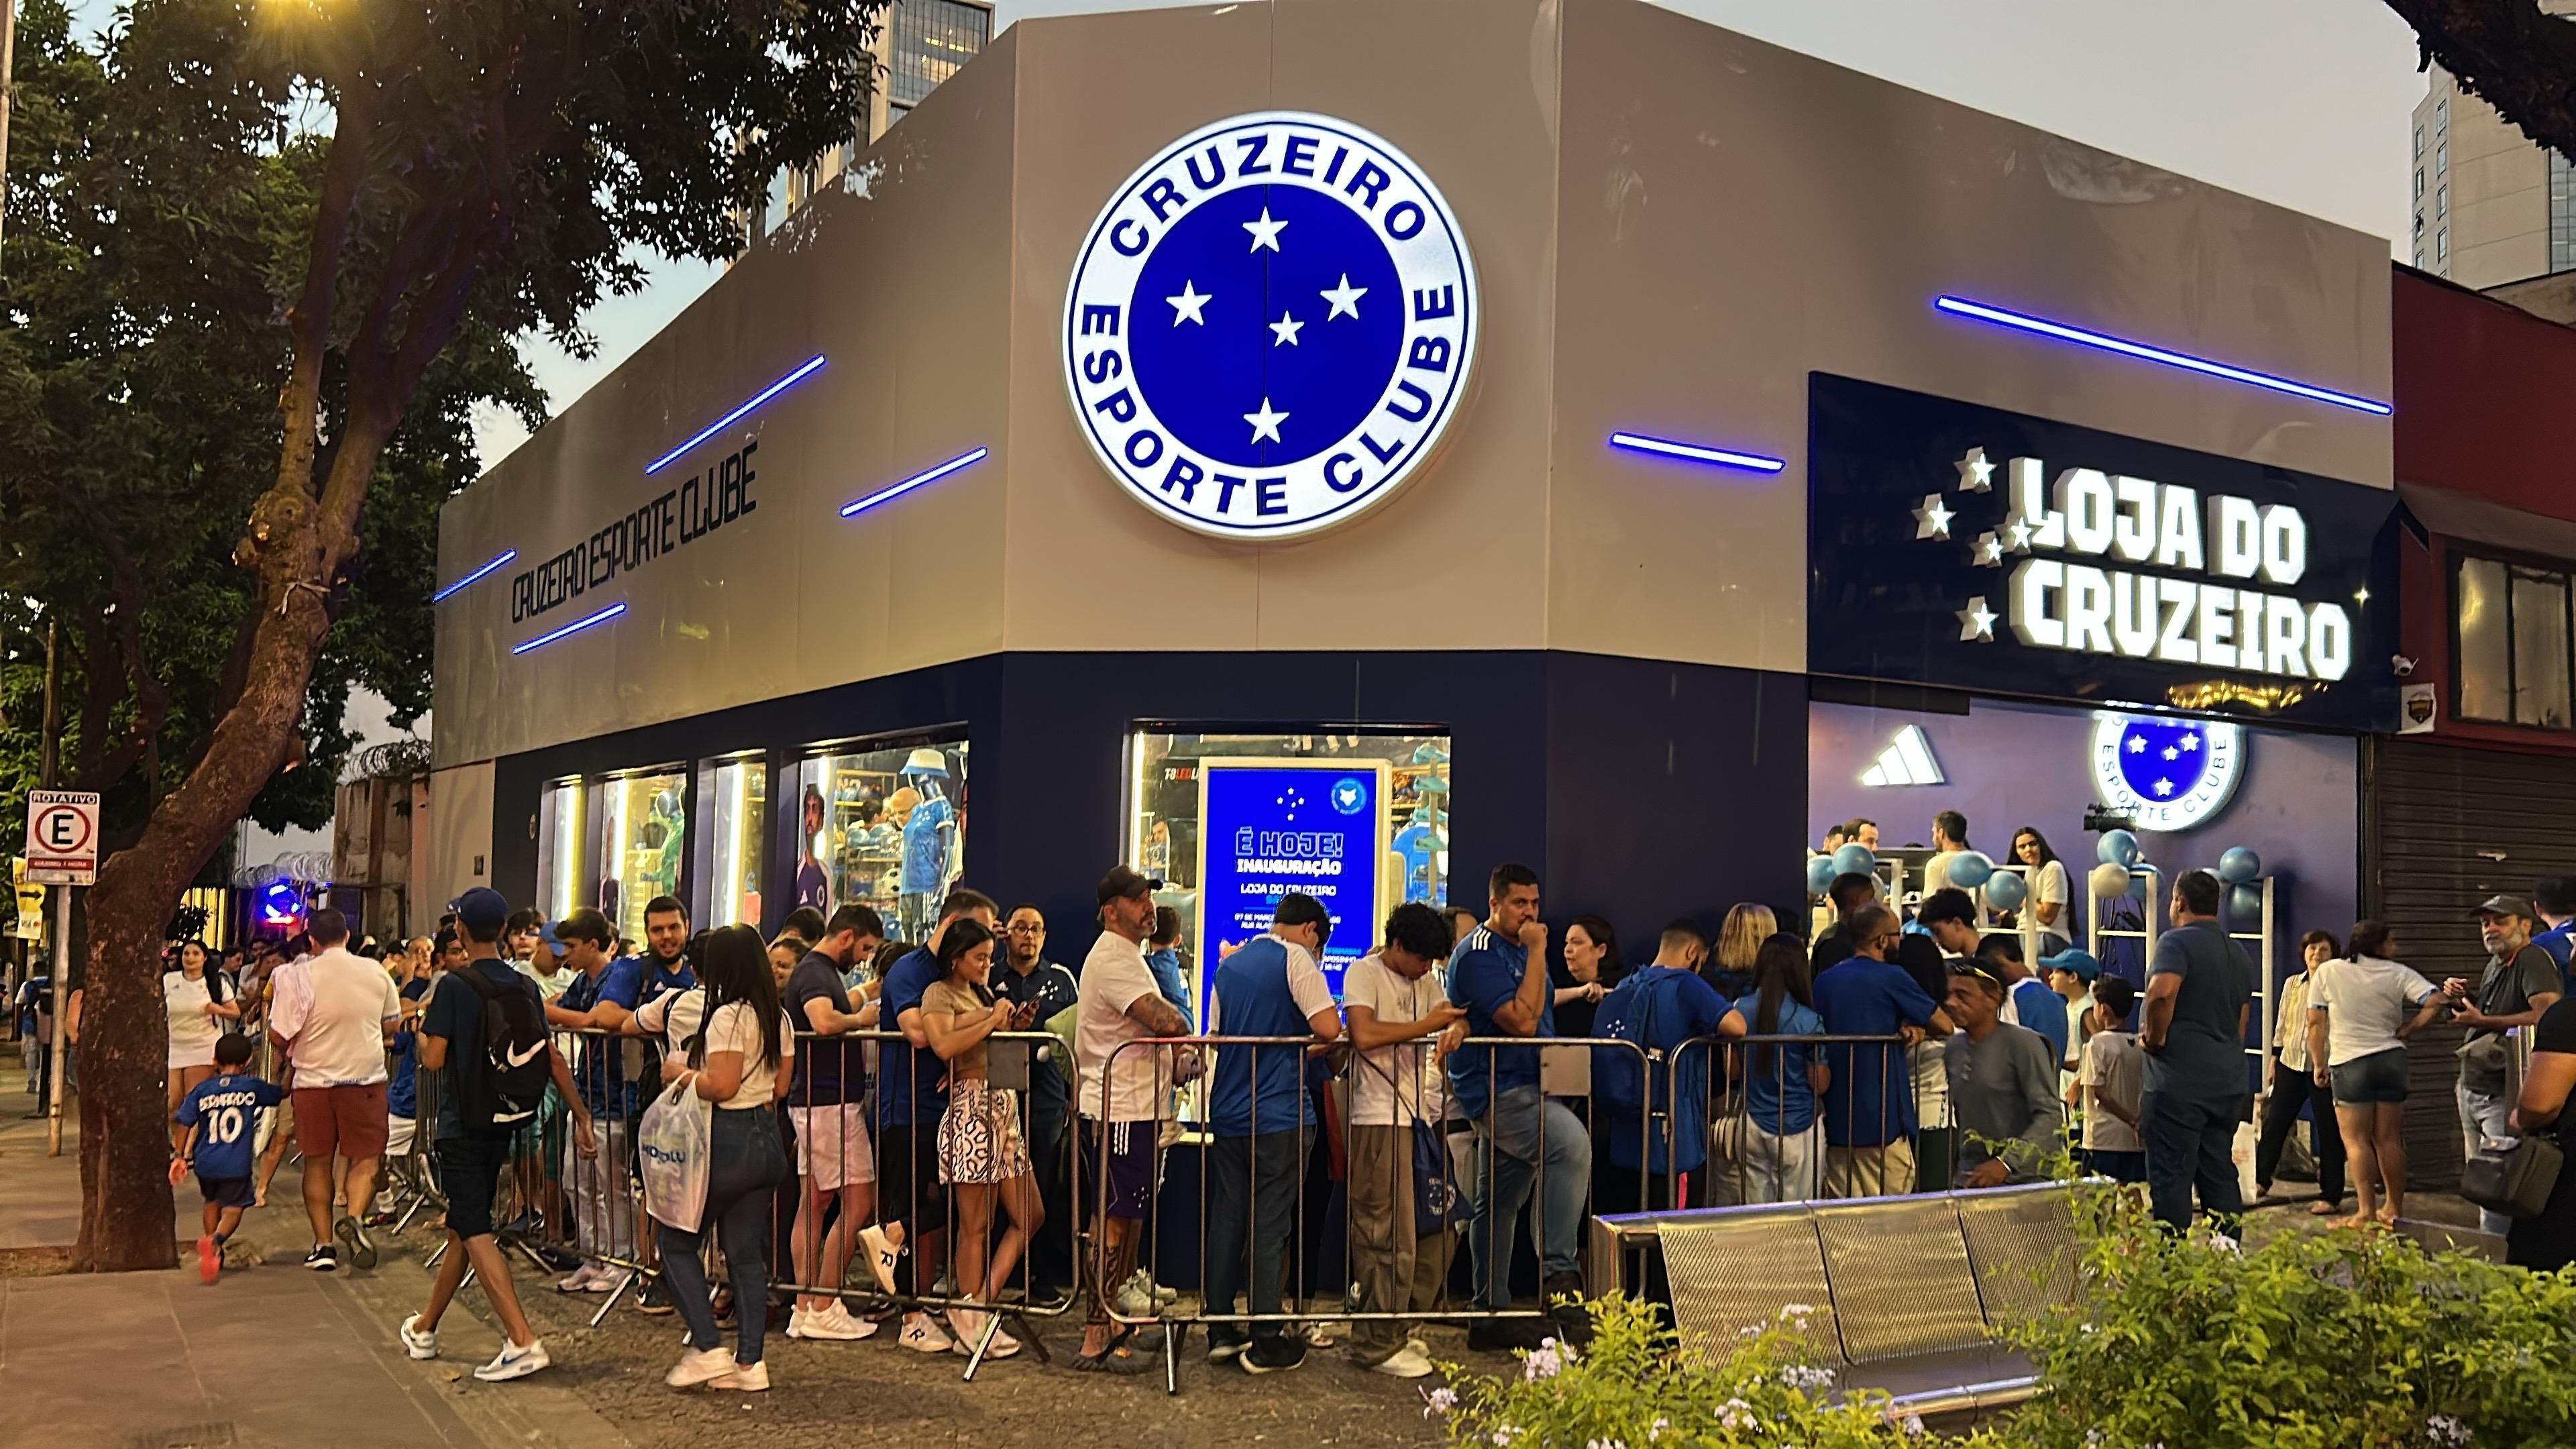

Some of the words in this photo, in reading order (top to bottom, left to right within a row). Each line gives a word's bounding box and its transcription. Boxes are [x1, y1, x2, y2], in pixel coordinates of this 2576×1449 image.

[1110, 134, 1426, 257] CRUZEIRO
[1081, 303, 1289, 517] ESPORTE
[1323, 283, 1455, 493] CLUBE
[512, 541, 587, 624] CRUZEIRO
[589, 488, 677, 588] ESPORTE
[680, 439, 759, 545] CLUBE
[2009, 456, 2204, 570] LOJA
[2208, 494, 2307, 585] DO
[2009, 557, 2351, 682] CRUZEIRO
[33, 792, 96, 804] ROTATIVO
[2183, 739, 2227, 813] CLUBE
[52, 814, 74, 845] E
[1235, 826, 1253, 856] É
[1260, 831, 1344, 858] HOJE!
[1236, 858, 1342, 877] INAUGURAÇÃO
[1241, 883, 1267, 894] LOJA
[1269, 884, 1284, 895] DO
[208, 1107, 244, 1144] 10
